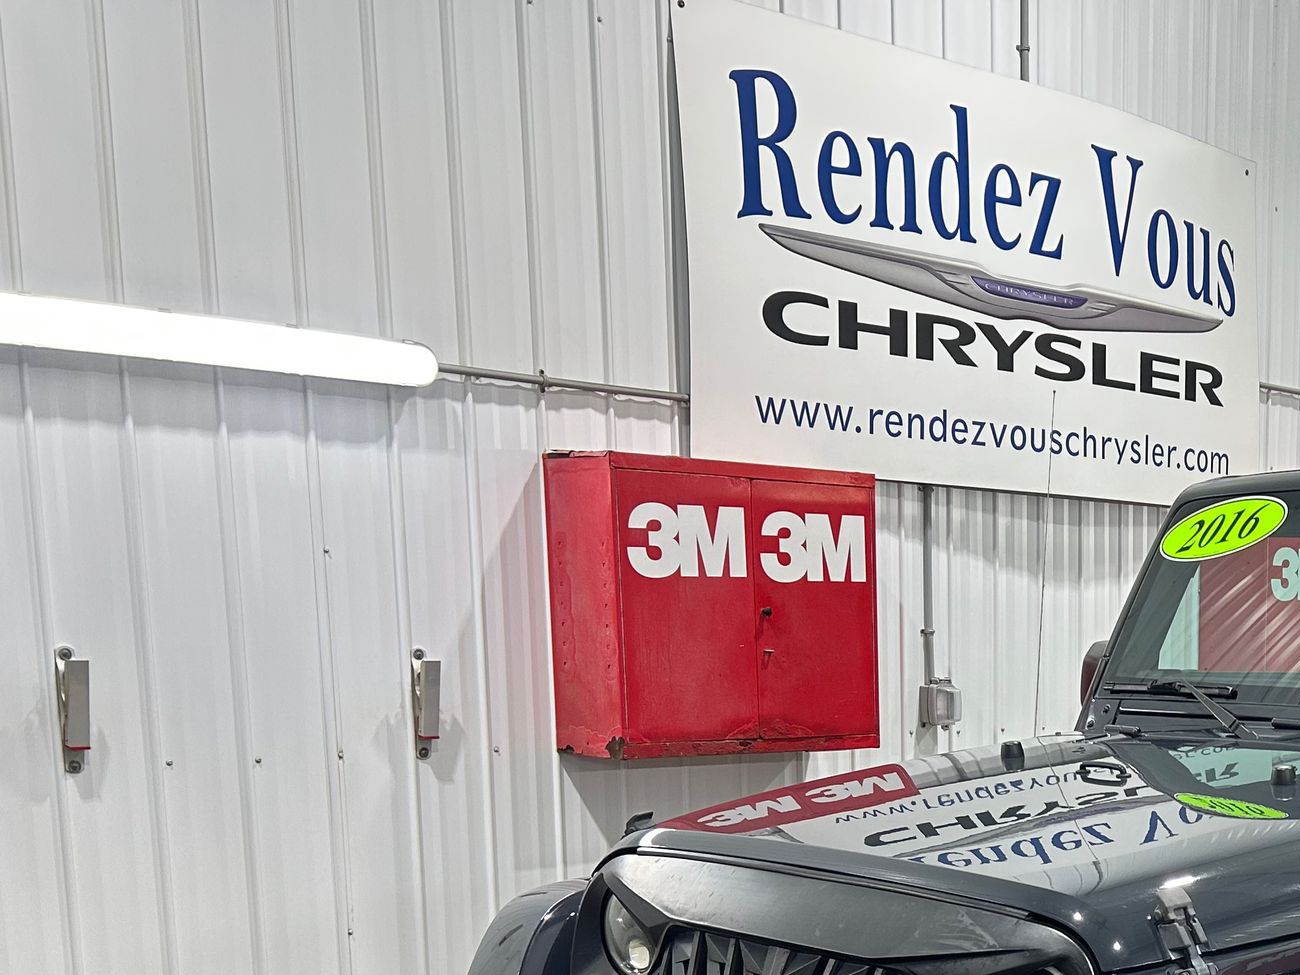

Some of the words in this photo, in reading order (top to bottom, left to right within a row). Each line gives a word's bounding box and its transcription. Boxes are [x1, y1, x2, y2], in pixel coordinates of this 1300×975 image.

[728, 69, 1064, 261] Rendez
[1091, 144, 1238, 318] Vous
[761, 290, 1224, 408] CHRYSLER
[754, 394, 1231, 477] www.rendezvouschrysler.com
[627, 502, 748, 579] 3M
[760, 510, 868, 584] 3M
[1175, 502, 1272, 554] 2016
